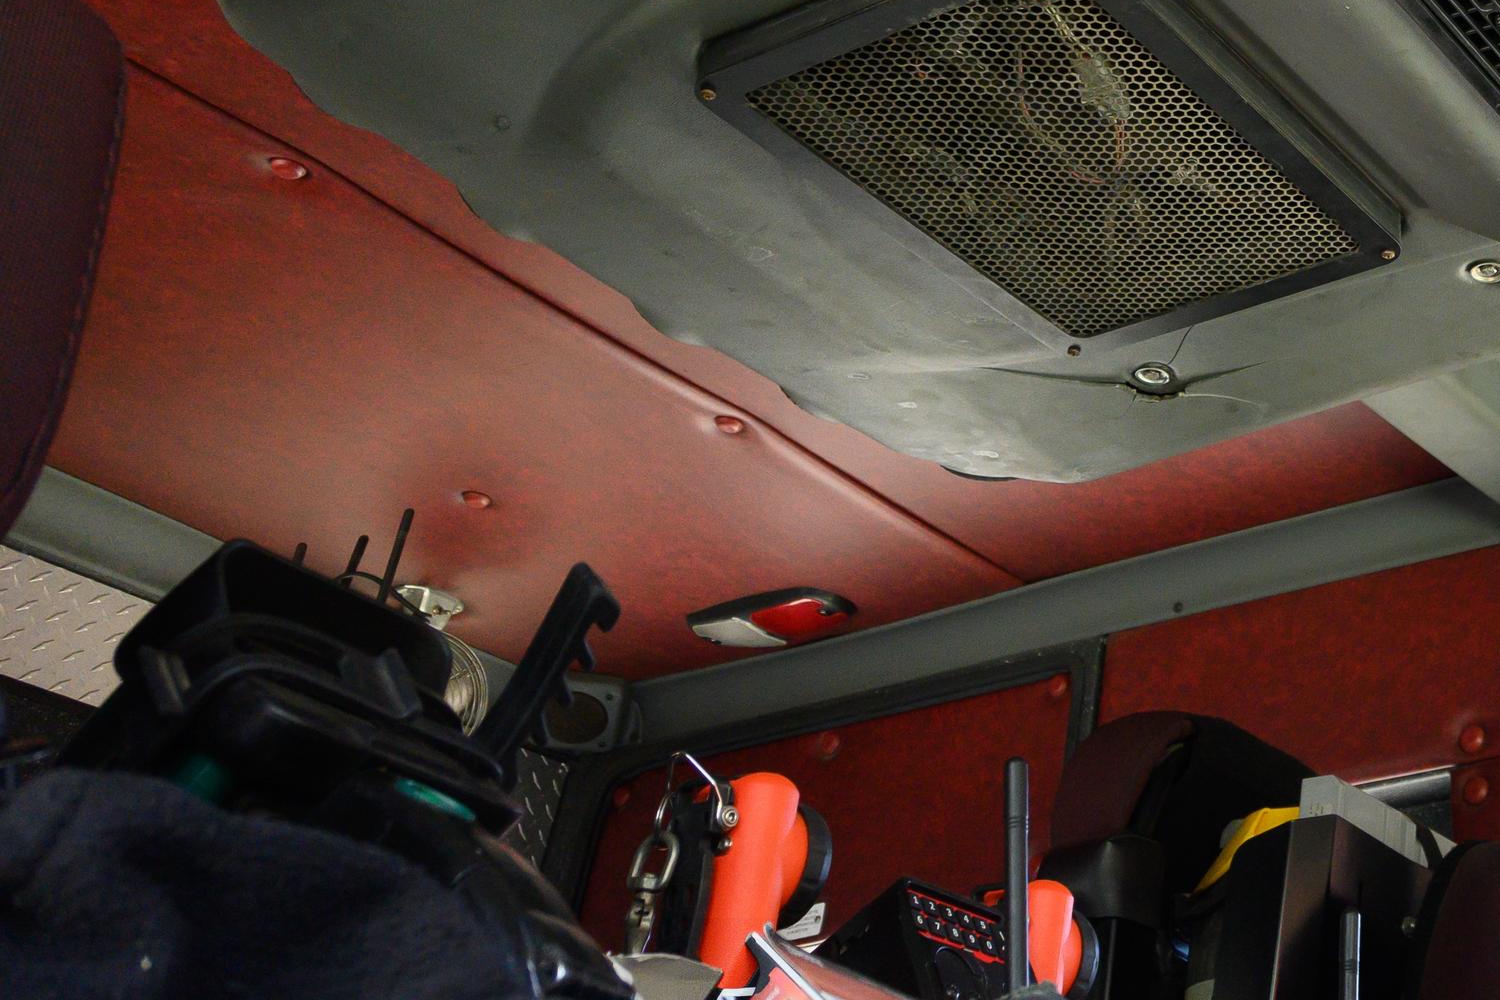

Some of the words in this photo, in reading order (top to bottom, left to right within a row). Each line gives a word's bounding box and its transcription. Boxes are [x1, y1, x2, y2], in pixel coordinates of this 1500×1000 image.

[913, 895, 919, 905] 1
[929, 901, 935, 911] 2
[946, 907, 952, 917] 3
[963, 914, 969, 924] 4
[980, 920, 986, 930] 5
[916, 915, 923, 925] 6
[935, 921, 940, 930] 7
[969, 934, 975, 944] 9
[986, 940, 993, 950] 0
